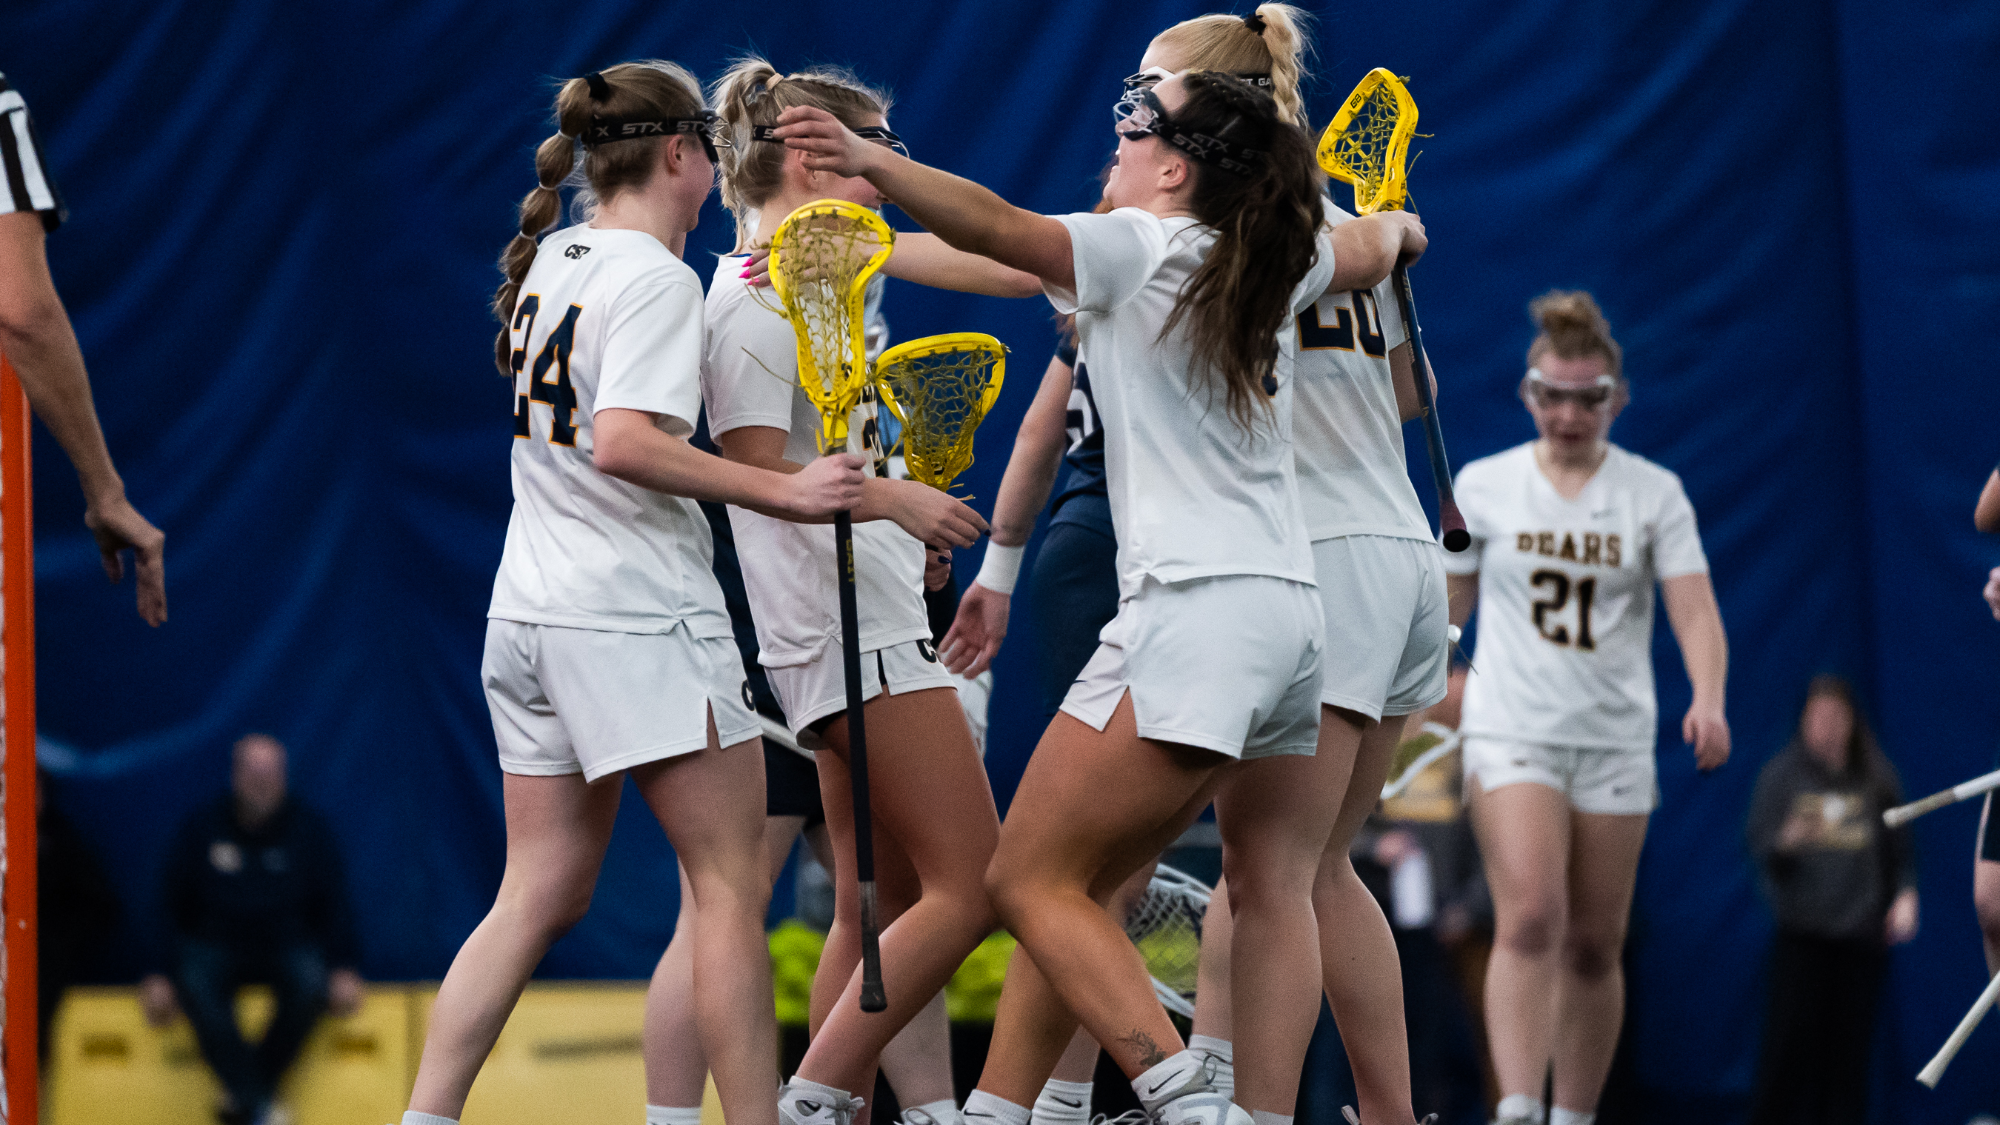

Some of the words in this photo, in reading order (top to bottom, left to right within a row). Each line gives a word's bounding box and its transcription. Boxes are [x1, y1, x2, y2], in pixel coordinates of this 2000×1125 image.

[621, 121, 663, 135] STX
[1172, 133, 1209, 159] STX
[511, 293, 583, 448] 24
[1530, 568, 1597, 651] 21
